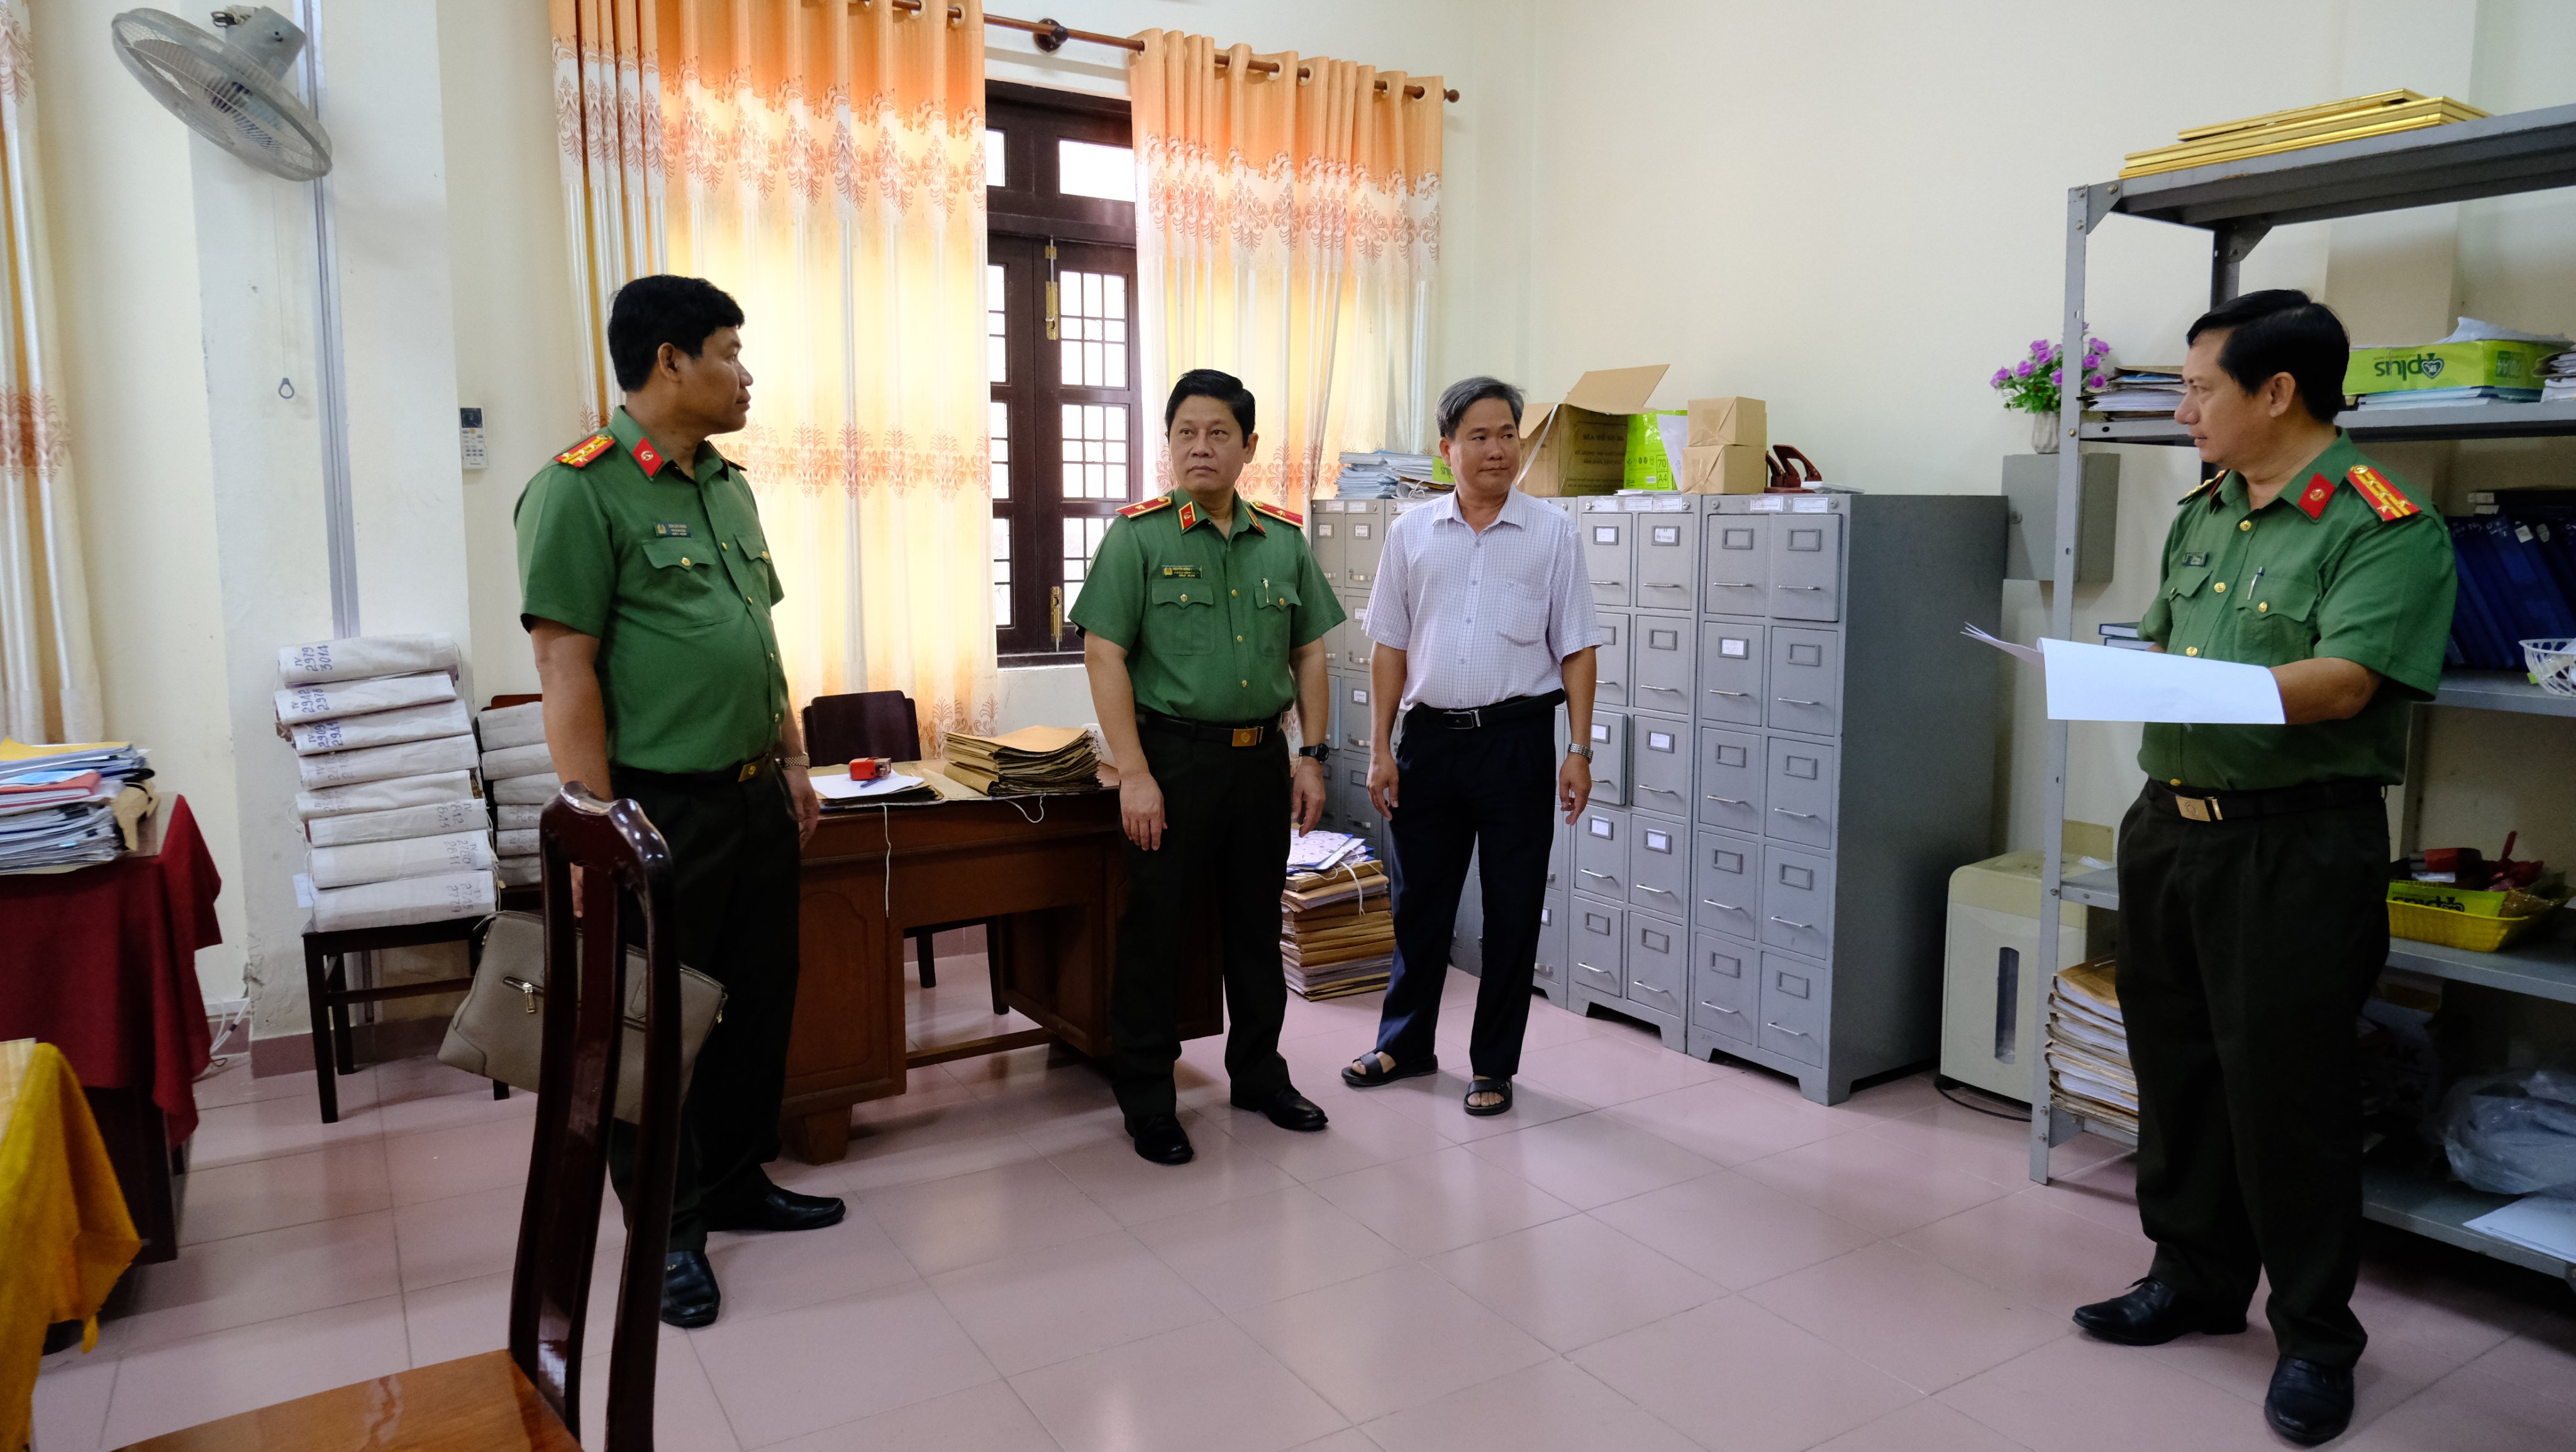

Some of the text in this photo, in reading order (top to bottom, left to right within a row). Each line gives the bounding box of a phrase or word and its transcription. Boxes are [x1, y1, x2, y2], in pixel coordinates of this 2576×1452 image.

[2374, 354, 2423, 381] plus
[1657, 459, 1667, 468] 70
[1658, 474, 1668, 483] A4
[302, 647, 318, 671] 2979
[314, 724, 330, 748] 2909
[450, 801, 464, 827] 812
[457, 840, 472, 864] 2780
